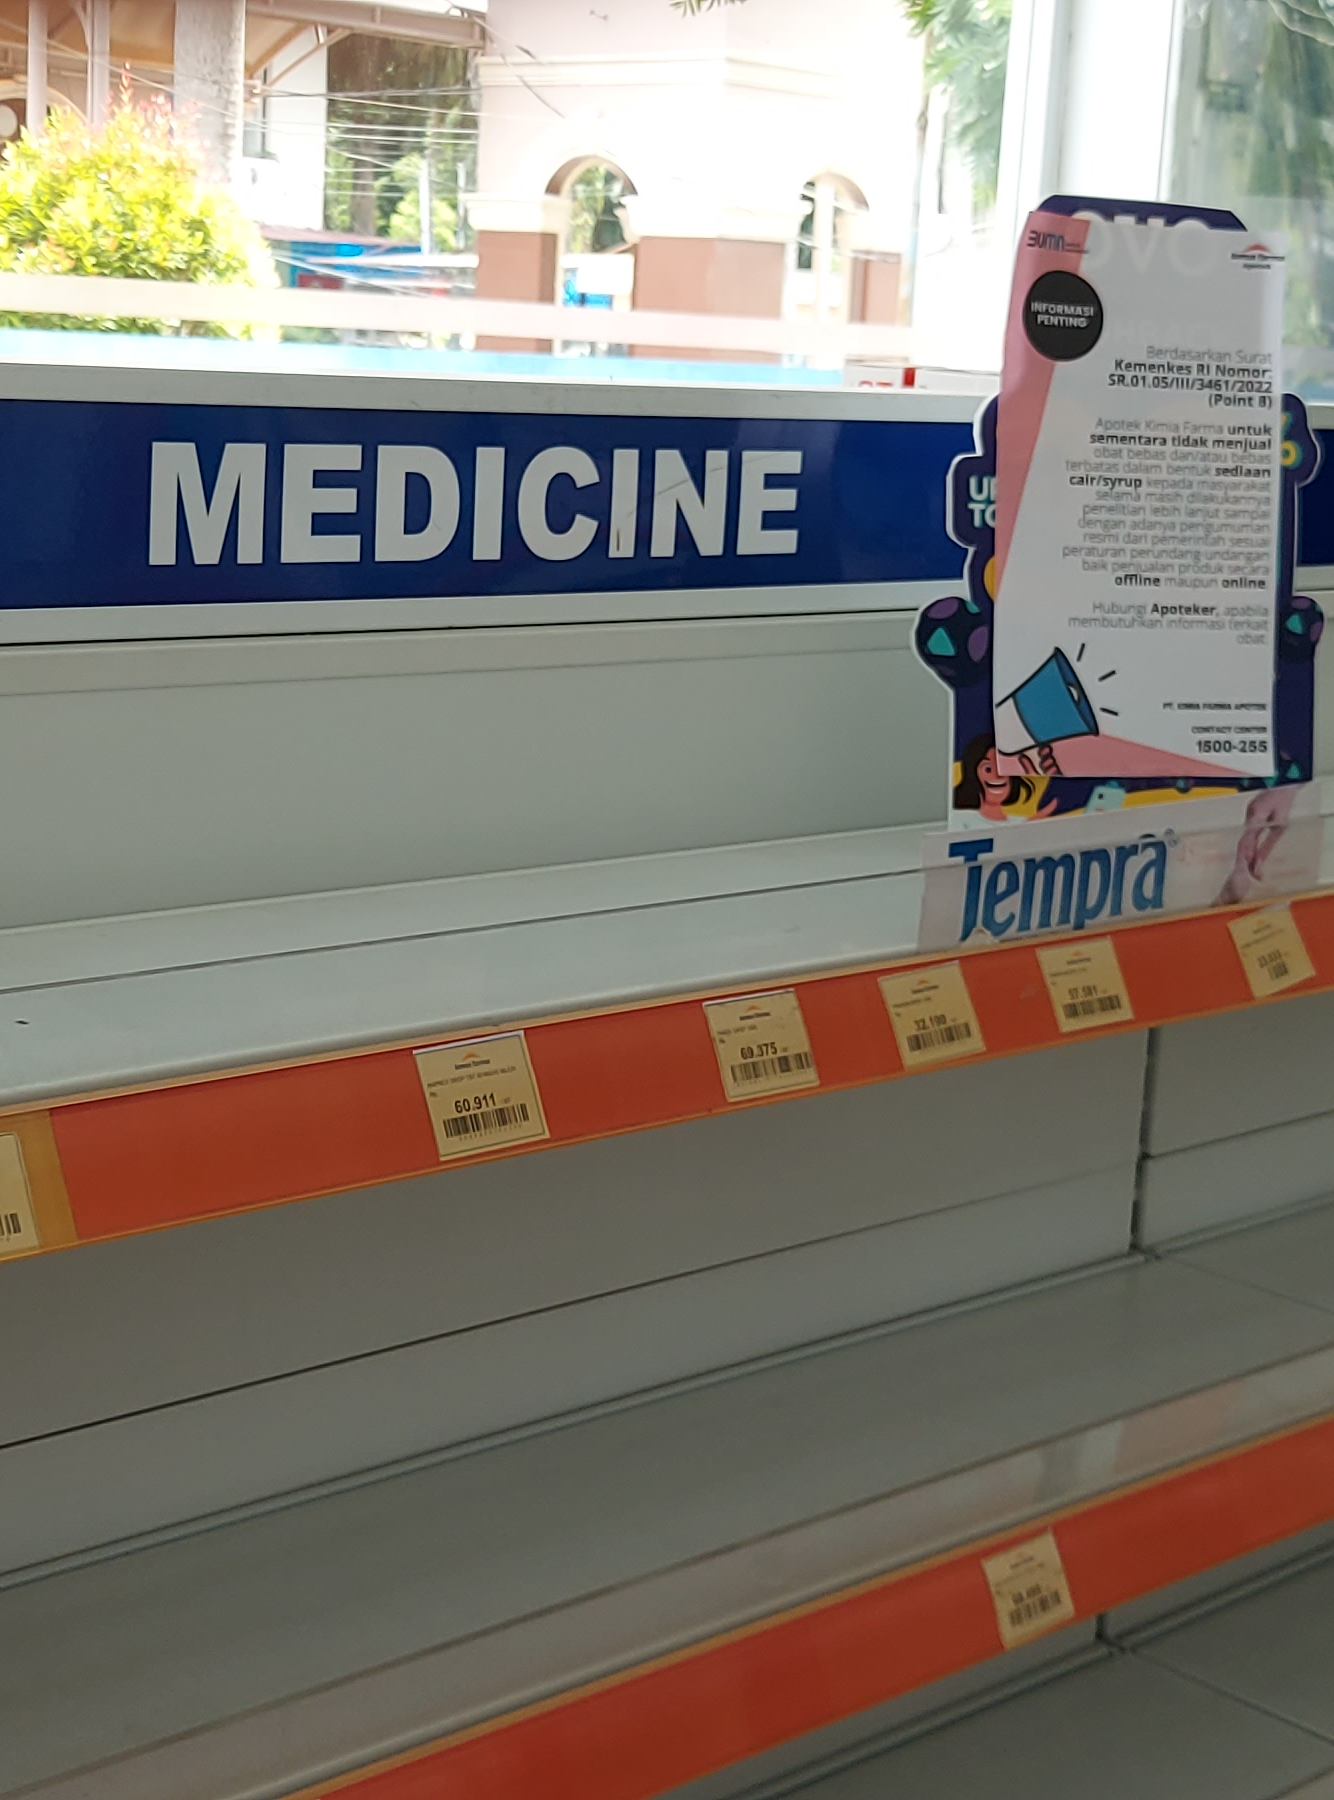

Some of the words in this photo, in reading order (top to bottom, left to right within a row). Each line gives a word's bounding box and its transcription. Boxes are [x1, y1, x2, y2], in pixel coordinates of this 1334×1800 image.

[1031, 302, 1094, 317] INFORMASI
[1037, 314, 1090, 328] PENTING
[1146, 346, 1231, 363] Berdasarkan
[1235, 350, 1272, 364] Surat
[1114, 359, 1192, 375] Kemenkes
[1196, 365, 1210, 376] RI
[1209, 393, 1254, 409] (Point
[1095, 417, 1140, 431] Apotek
[1144, 420, 1180, 433] Kimia
[1183, 422, 1224, 435] Farma
[1227, 424, 1272, 435] untuk
[1089, 433, 1167, 446] sementara
[1171, 435, 1208, 448] tidak
[1212, 437, 1272, 452] menjual
[1093, 447, 1124, 460] obat
[1127, 448, 1166, 460] bebas
[1169, 449, 1228, 463] dan/atau
[1231, 451, 1271, 464] bebas
[1066, 460, 1122, 473] terbatas
[1122, 461, 1162, 473] dalam
[1167, 463, 1210, 476] bentuk
[1214, 465, 1271, 477] sediaan
[1069, 474, 1142, 490] cair/syrup
[1146, 479, 1193, 491] kepada
[1197, 480, 1271, 494] masyarakat
[149, 441, 803, 565] MEDICINE
[1095, 490, 1141, 502] selama
[1144, 492, 1183, 504] masih
[1187, 493, 1271, 507] dilakukannya
[1082, 503, 1146, 518] penelitian
[1150, 506, 1181, 518] lebih
[1184, 507, 1219, 520] lanjut
[1223, 509, 1271, 521] sampai
[1077, 518, 1126, 532] dengan
[1129, 519, 1177, 533] adanya
[1179, 522, 1271, 536] pengumuman
[1083, 532, 1119, 544] resmi
[1122, 533, 1148, 545] dari
[1151, 534, 1226, 549] pemerintah
[1228, 536, 1269, 548] sesuai
[1062, 546, 1126, 560] peraturan
[1082, 559, 1109, 571] baik
[1111, 560, 1175, 575] penjualan
[1178, 562, 1224, 575] produk
[1226, 565, 1270, 576] secara
[1114, 574, 1162, 587] offline
[1164, 577, 1218, 590] maupun
[1092, 602, 1147, 617] Hubungi
[1223, 605, 1269, 618] apabila
[1068, 615, 1163, 630] membutuhkan
[1167, 617, 1226, 631] informasi
[1228, 619, 1269, 631] terkait
[1197, 740, 1268, 753] 1500-255
[948, 830, 1169, 942] Tempra
[454, 1092, 496, 1114] 60.911
